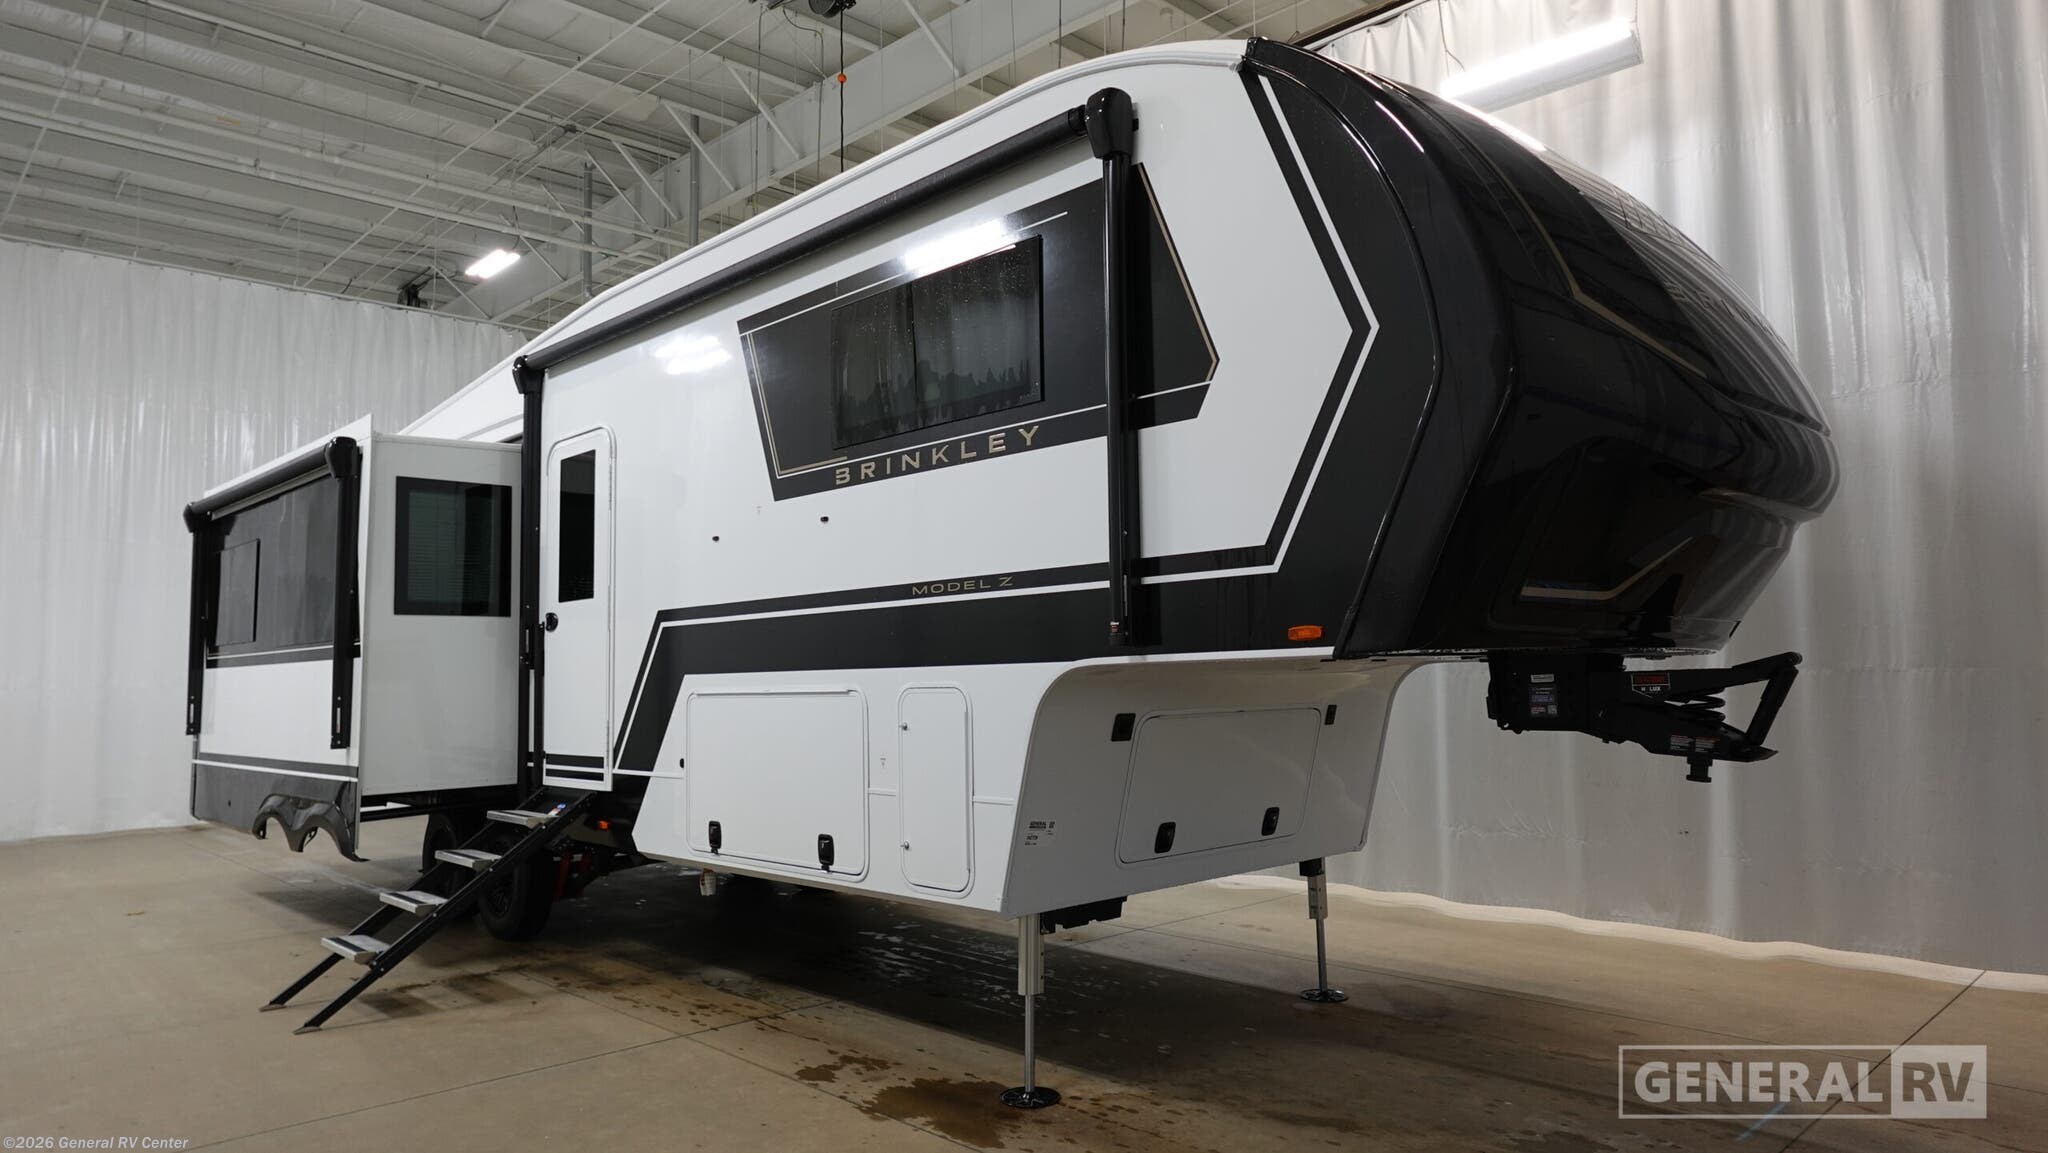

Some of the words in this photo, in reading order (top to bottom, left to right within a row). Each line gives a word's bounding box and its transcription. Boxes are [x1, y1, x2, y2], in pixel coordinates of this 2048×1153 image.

[835, 425, 1039, 485] BRINKLEY
[912, 579, 991, 596] MODEL
[999, 576, 1014, 587] Z
